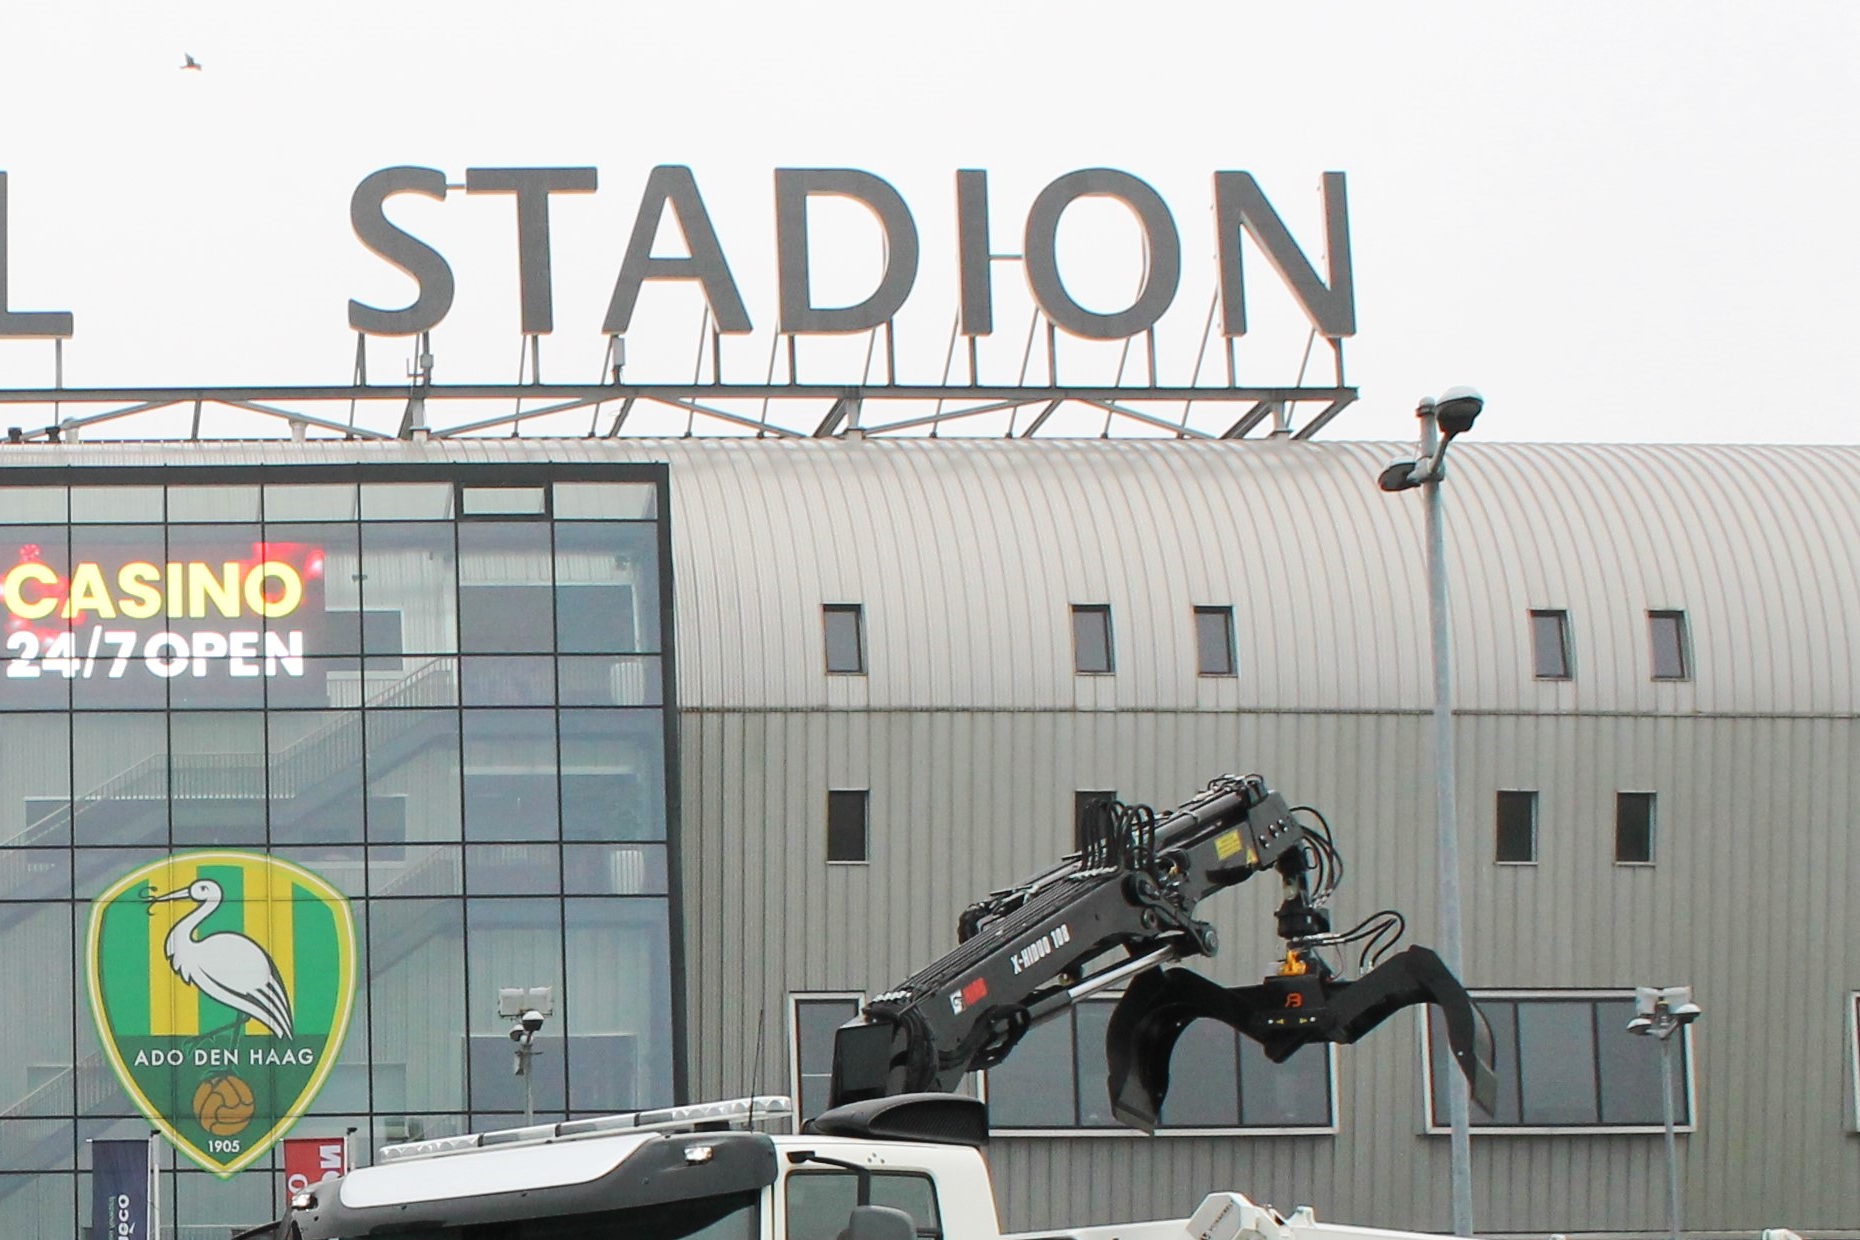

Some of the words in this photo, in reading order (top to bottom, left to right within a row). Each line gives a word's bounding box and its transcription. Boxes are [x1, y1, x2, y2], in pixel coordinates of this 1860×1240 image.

[348, 164, 1357, 341] STADION
[2, 560, 304, 620] CASINO
[5, 626, 138, 679] 24/7
[143, 629, 306, 678] OPEN
[133, 1049, 184, 1067] ADO
[194, 1049, 239, 1067] DEN
[250, 1048, 315, 1067] HAAG
[207, 1139, 241, 1154] 1905
